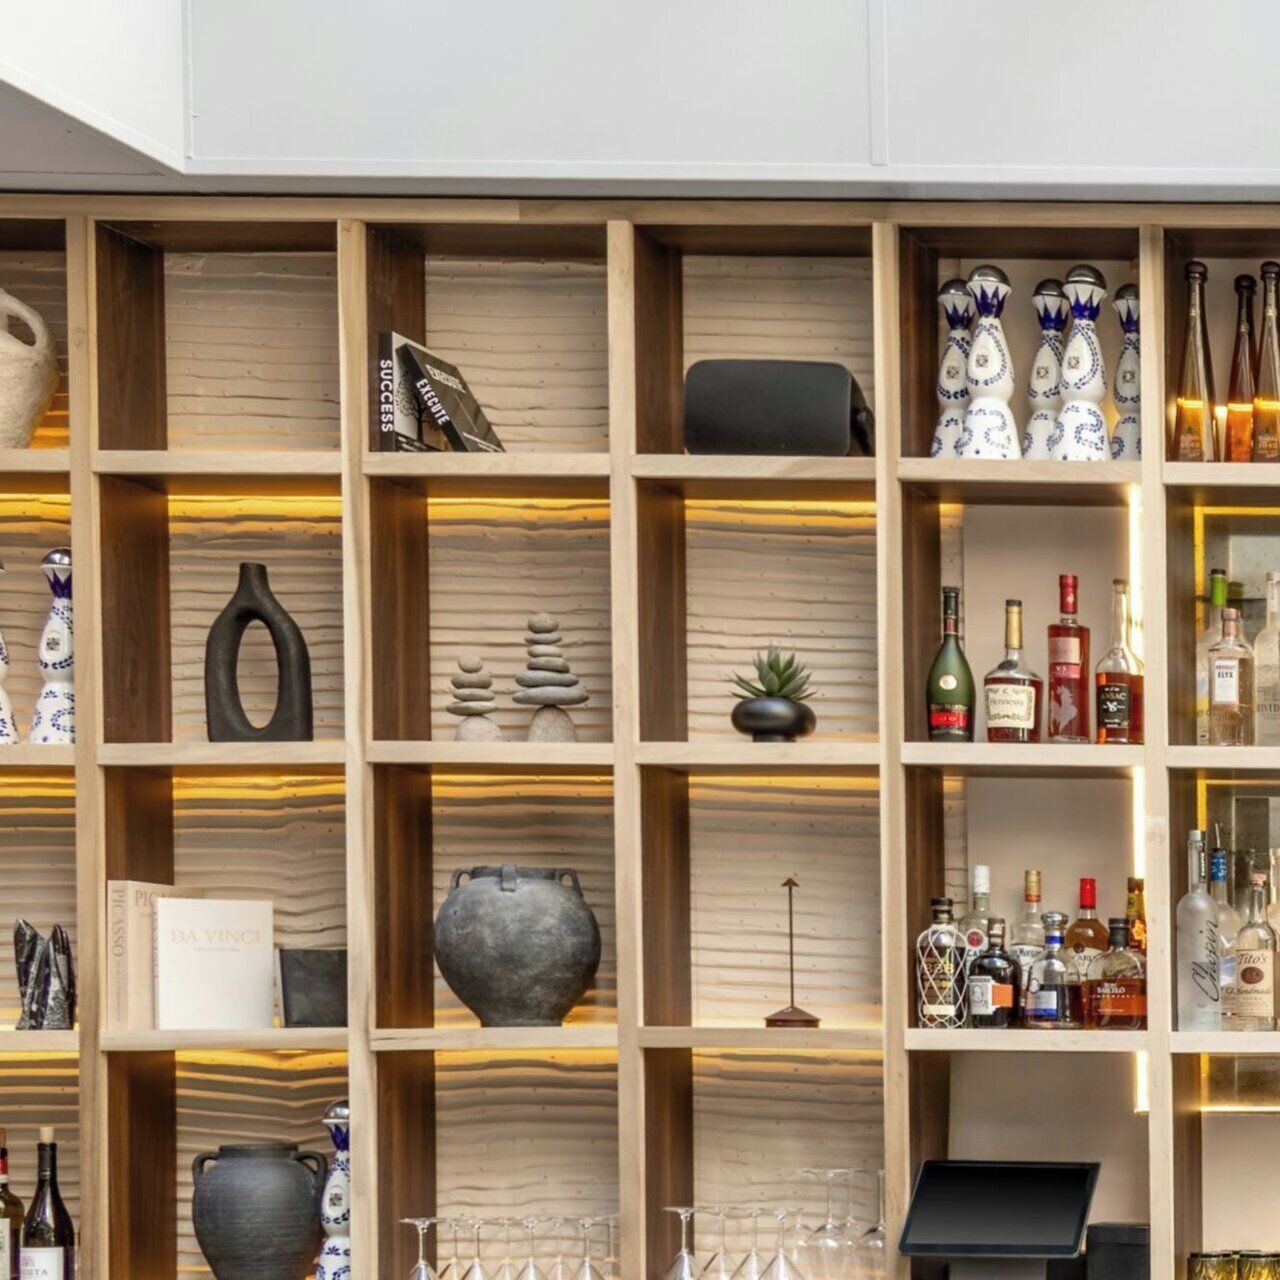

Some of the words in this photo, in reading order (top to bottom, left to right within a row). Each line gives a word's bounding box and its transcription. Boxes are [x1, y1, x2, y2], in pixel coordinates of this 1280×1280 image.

[380, 359, 394, 432] SUCCESS
[415, 377, 450, 426] EXECUTE
[111, 889, 126, 959] PICASSO
[170, 928, 202, 945] DA
[208, 929, 262, 946] VINCI
[1191, 919, 1220, 1003] Chopin
[1236, 952, 1268, 965] Tito's
